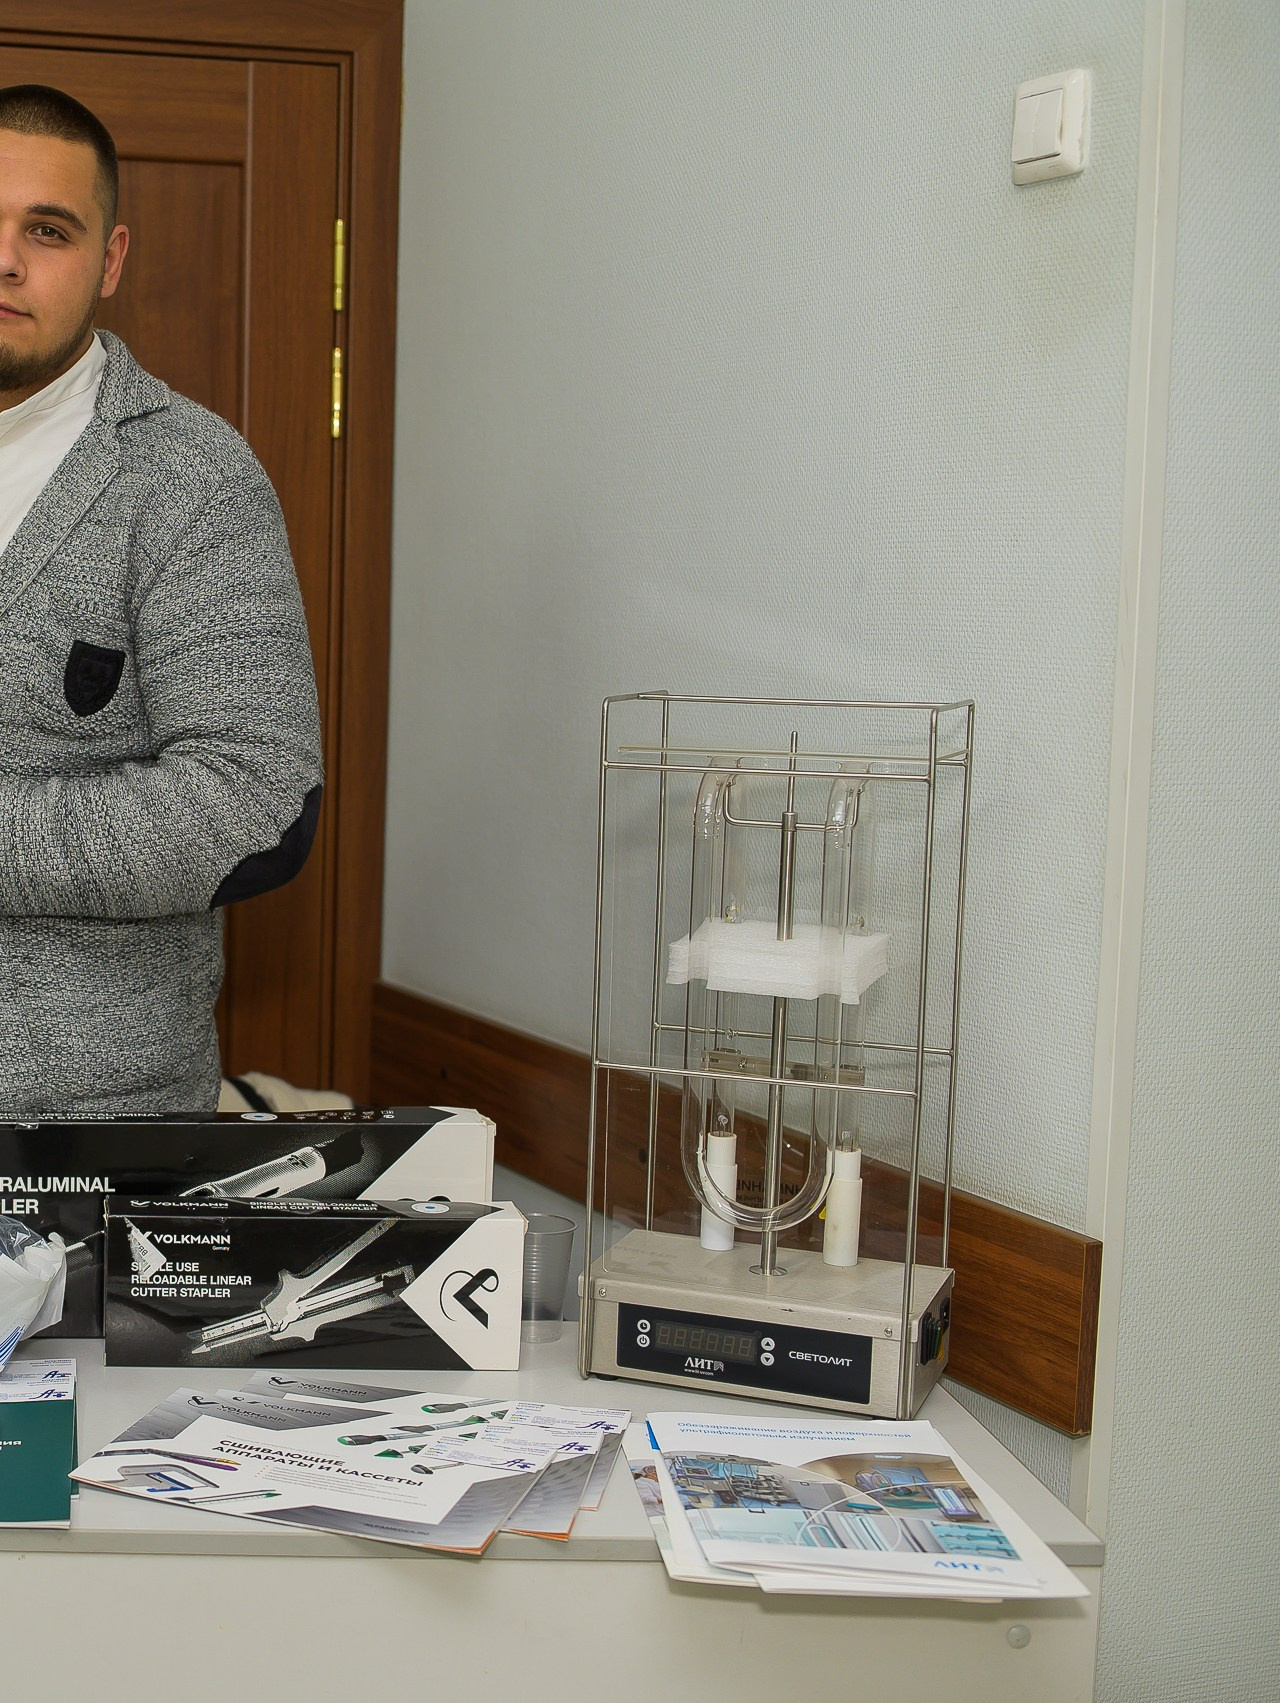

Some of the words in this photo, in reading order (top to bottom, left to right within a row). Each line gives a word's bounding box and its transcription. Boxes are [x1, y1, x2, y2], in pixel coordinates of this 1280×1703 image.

[153, 1234, 231, 1245] VOLKMANN
[131, 1262, 174, 1272] SILE
[176, 1262, 200, 1272] USE
[131, 1275, 207, 1285] RELOADABLE
[210, 1275, 252, 1285] LINEAR
[131, 1287, 177, 1298] CUTTER
[180, 1287, 231, 1298] STAPLER
[684, 1356, 714, 1370] ЛИТ
[788, 1351, 853, 1367] СВЕТОЛИТ
[300, 1382, 368, 1396] VOLKMANN
[221, 1404, 287, 1422] VOLKMANN
[263, 1403, 332, 1417] VOLKMANN
[677, 1422, 777, 1432] Обеззараживание
[679, 1428, 787, 1439] ультрафиолетовым
[219, 1439, 346, 1467] СШИВАЮЩИЕ
[212, 1446, 315, 1469] АППАРАТЫ
[335, 1468, 424, 1487] КАССЕТЫ
